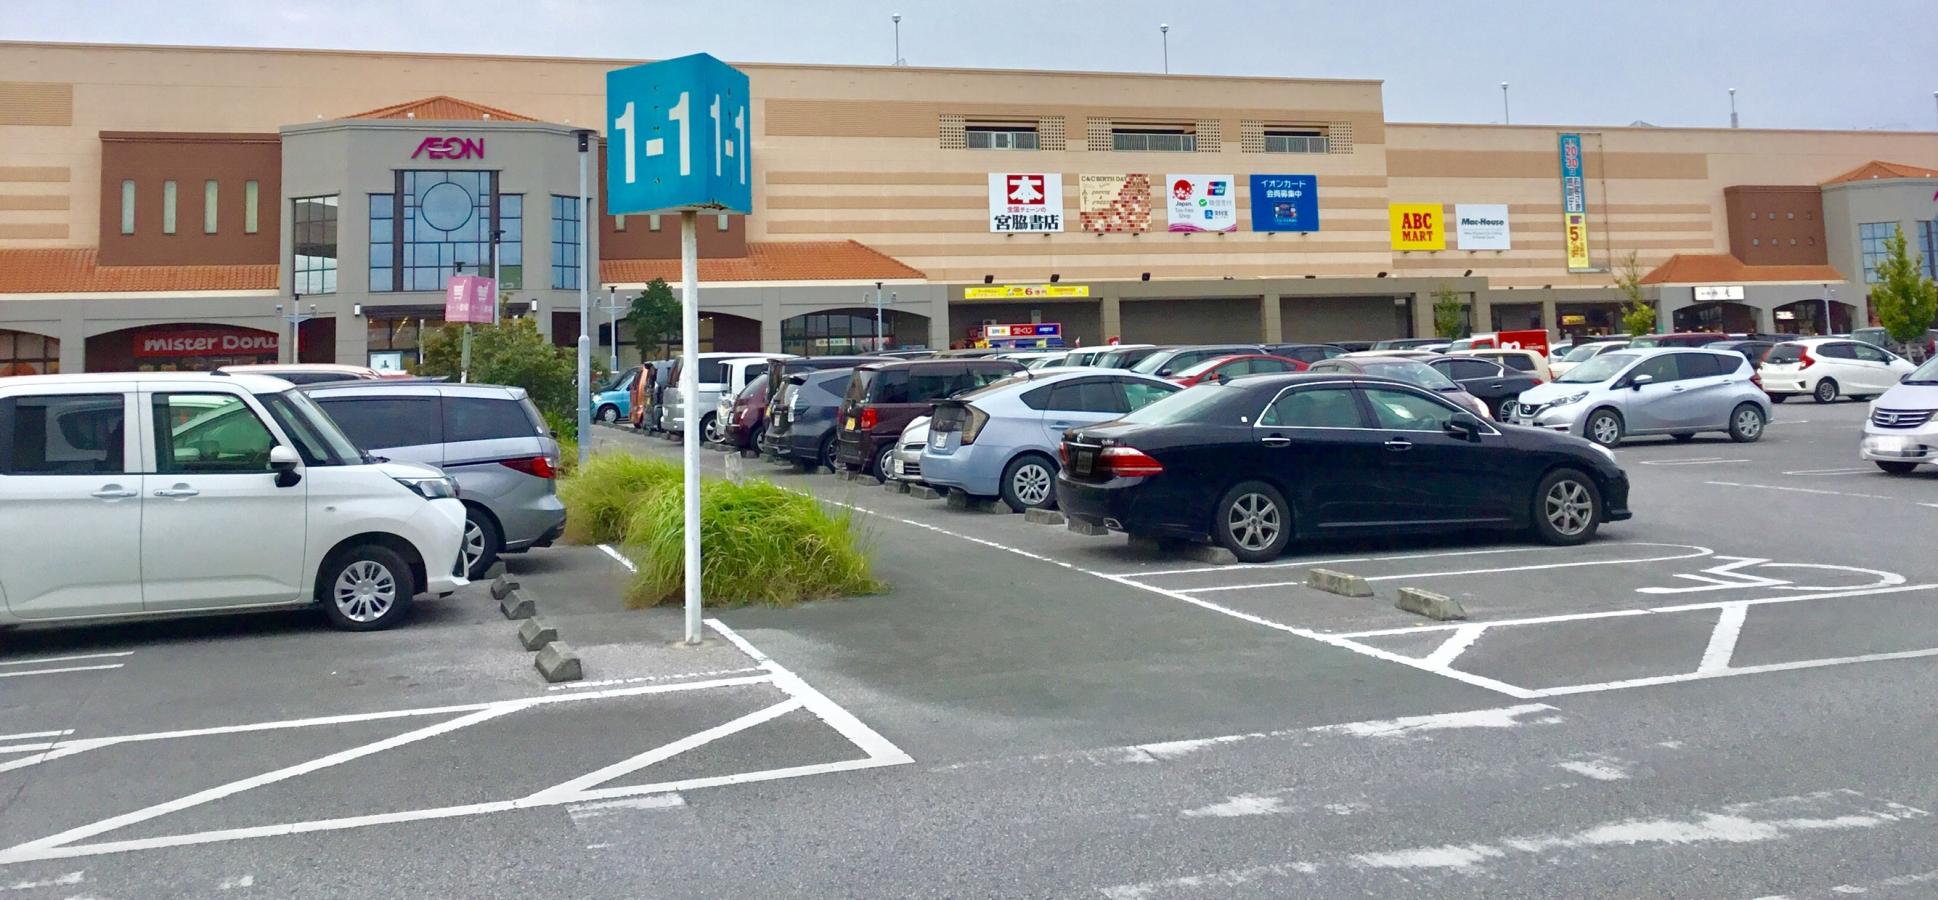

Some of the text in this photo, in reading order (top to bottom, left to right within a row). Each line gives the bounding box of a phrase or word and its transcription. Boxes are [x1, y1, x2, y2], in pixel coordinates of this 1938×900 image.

[615, 91, 690, 184] 1-1
[710, 93, 746, 185] 1-1
[1009, 176, 1043, 203] 本
[1261, 179, 1307, 189] イオンカード
[994, 214, 1060, 231] 宮脇書店
[1402, 213, 1432, 229] ABC
[1461, 218, 1504, 226] Mac-House
[1402, 230, 1433, 241] MART
[144, 335, 279, 351] mister Donu
